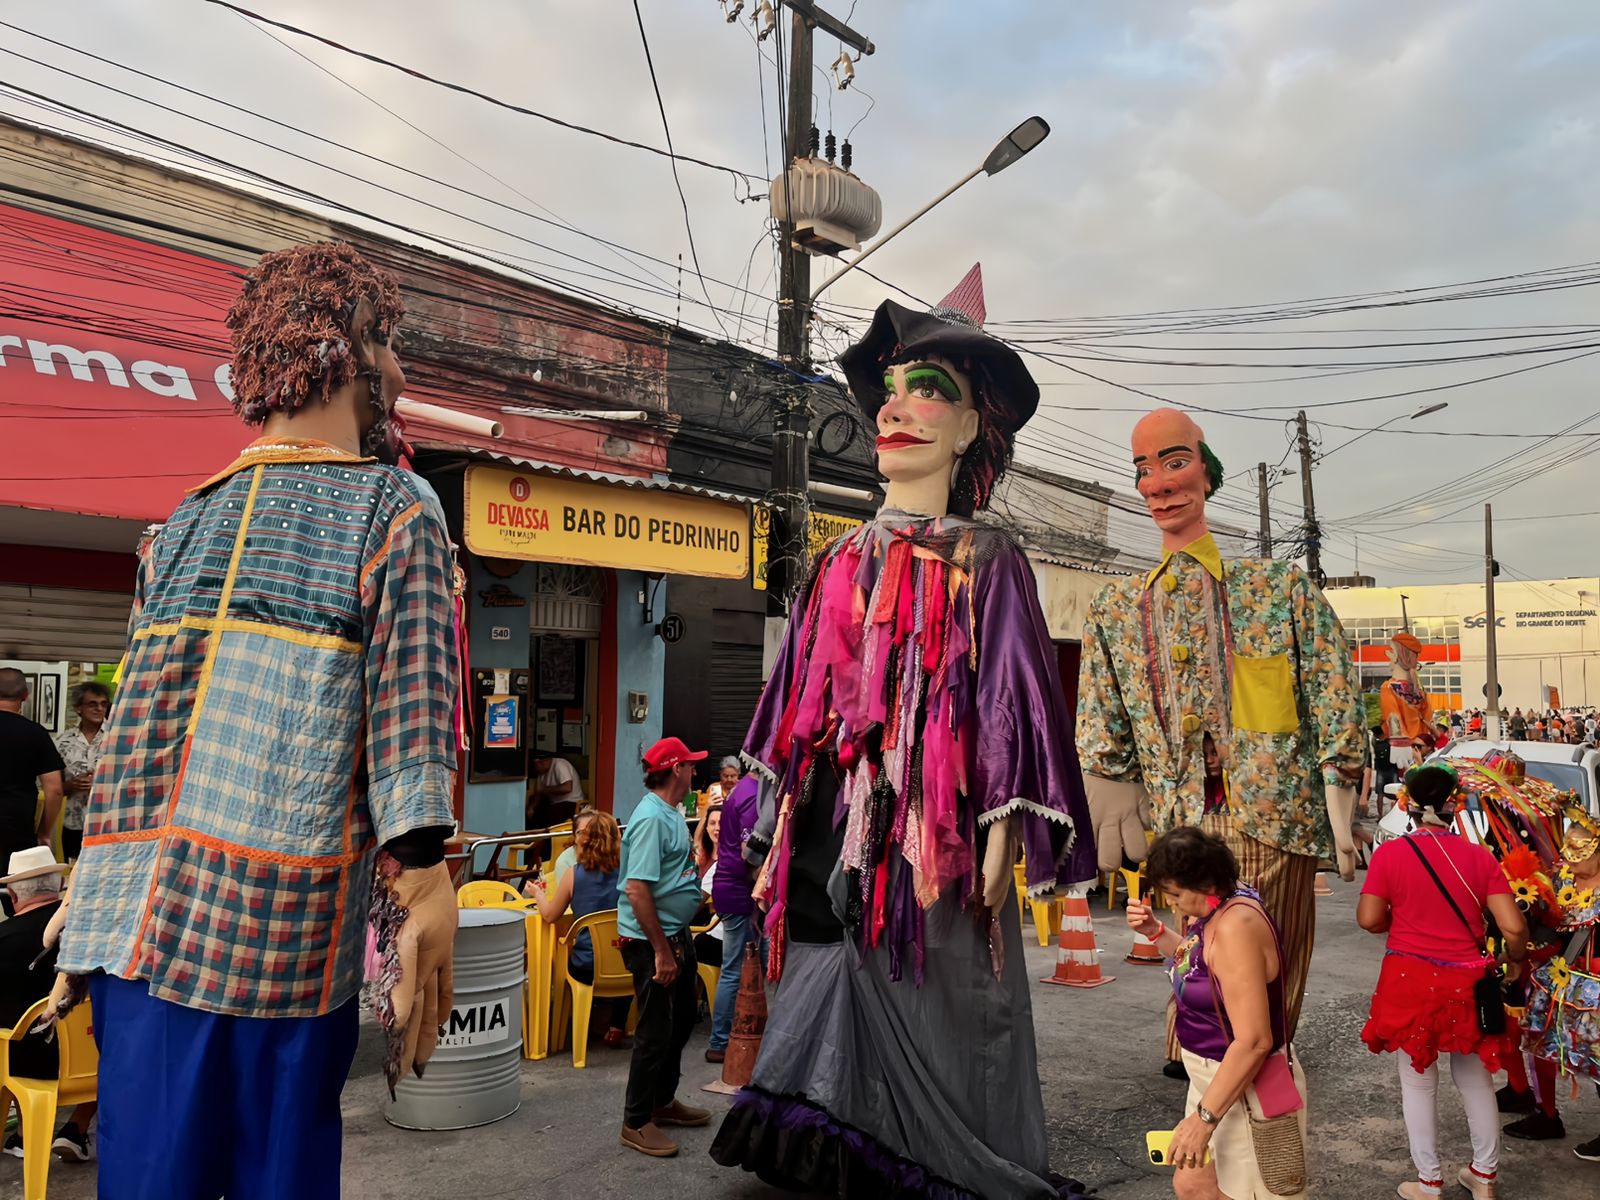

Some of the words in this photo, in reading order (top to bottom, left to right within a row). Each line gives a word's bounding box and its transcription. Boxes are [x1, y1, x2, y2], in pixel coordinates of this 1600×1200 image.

[488, 502, 549, 531] DEVASSA
[563, 505, 606, 536] BAR
[614, 513, 640, 540] DO
[648, 518, 740, 553] PEDRINHO
[493, 629, 509, 638] 540
[667, 620, 679, 638] 51
